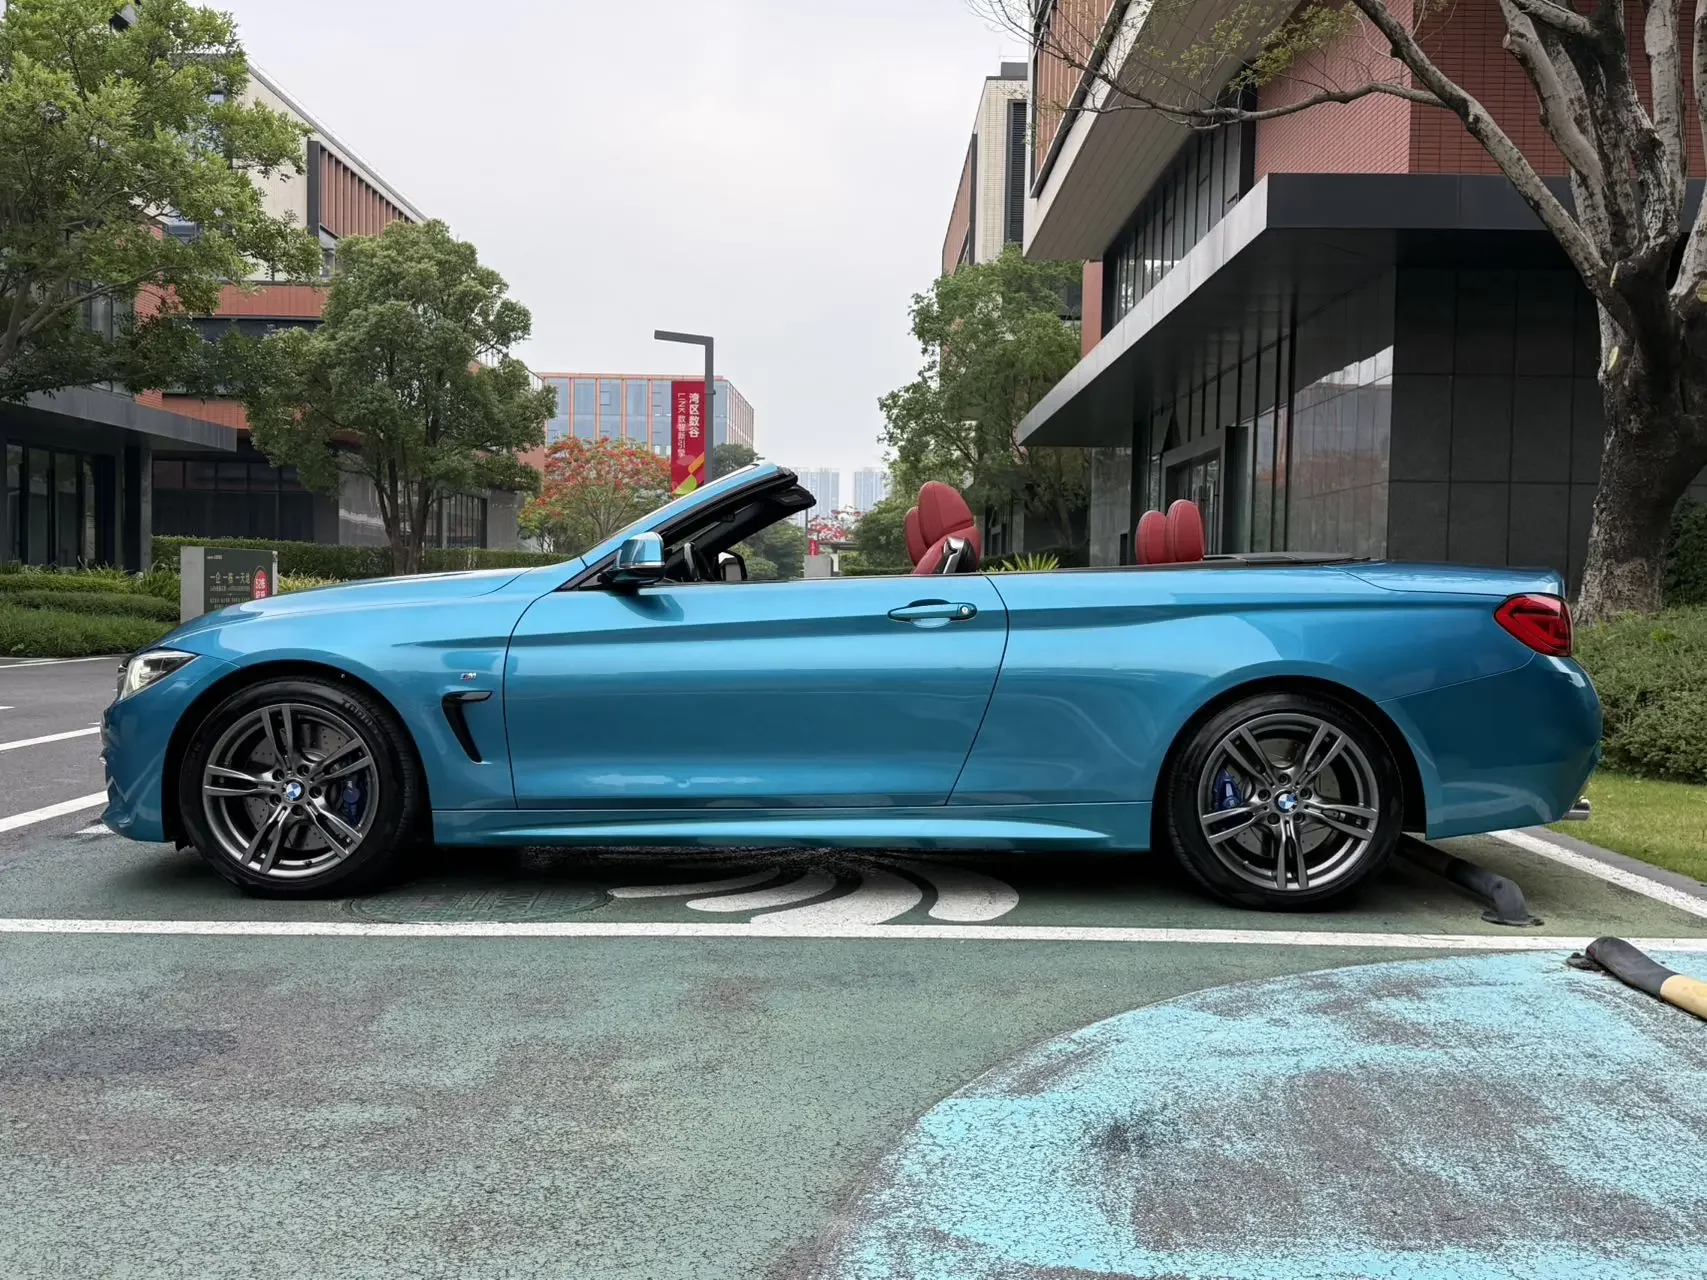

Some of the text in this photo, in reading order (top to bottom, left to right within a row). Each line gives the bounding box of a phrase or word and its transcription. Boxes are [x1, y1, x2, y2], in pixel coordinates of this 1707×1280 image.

[678, 393, 686, 413] LINK
[689, 393, 699, 437] 湾区数谷
